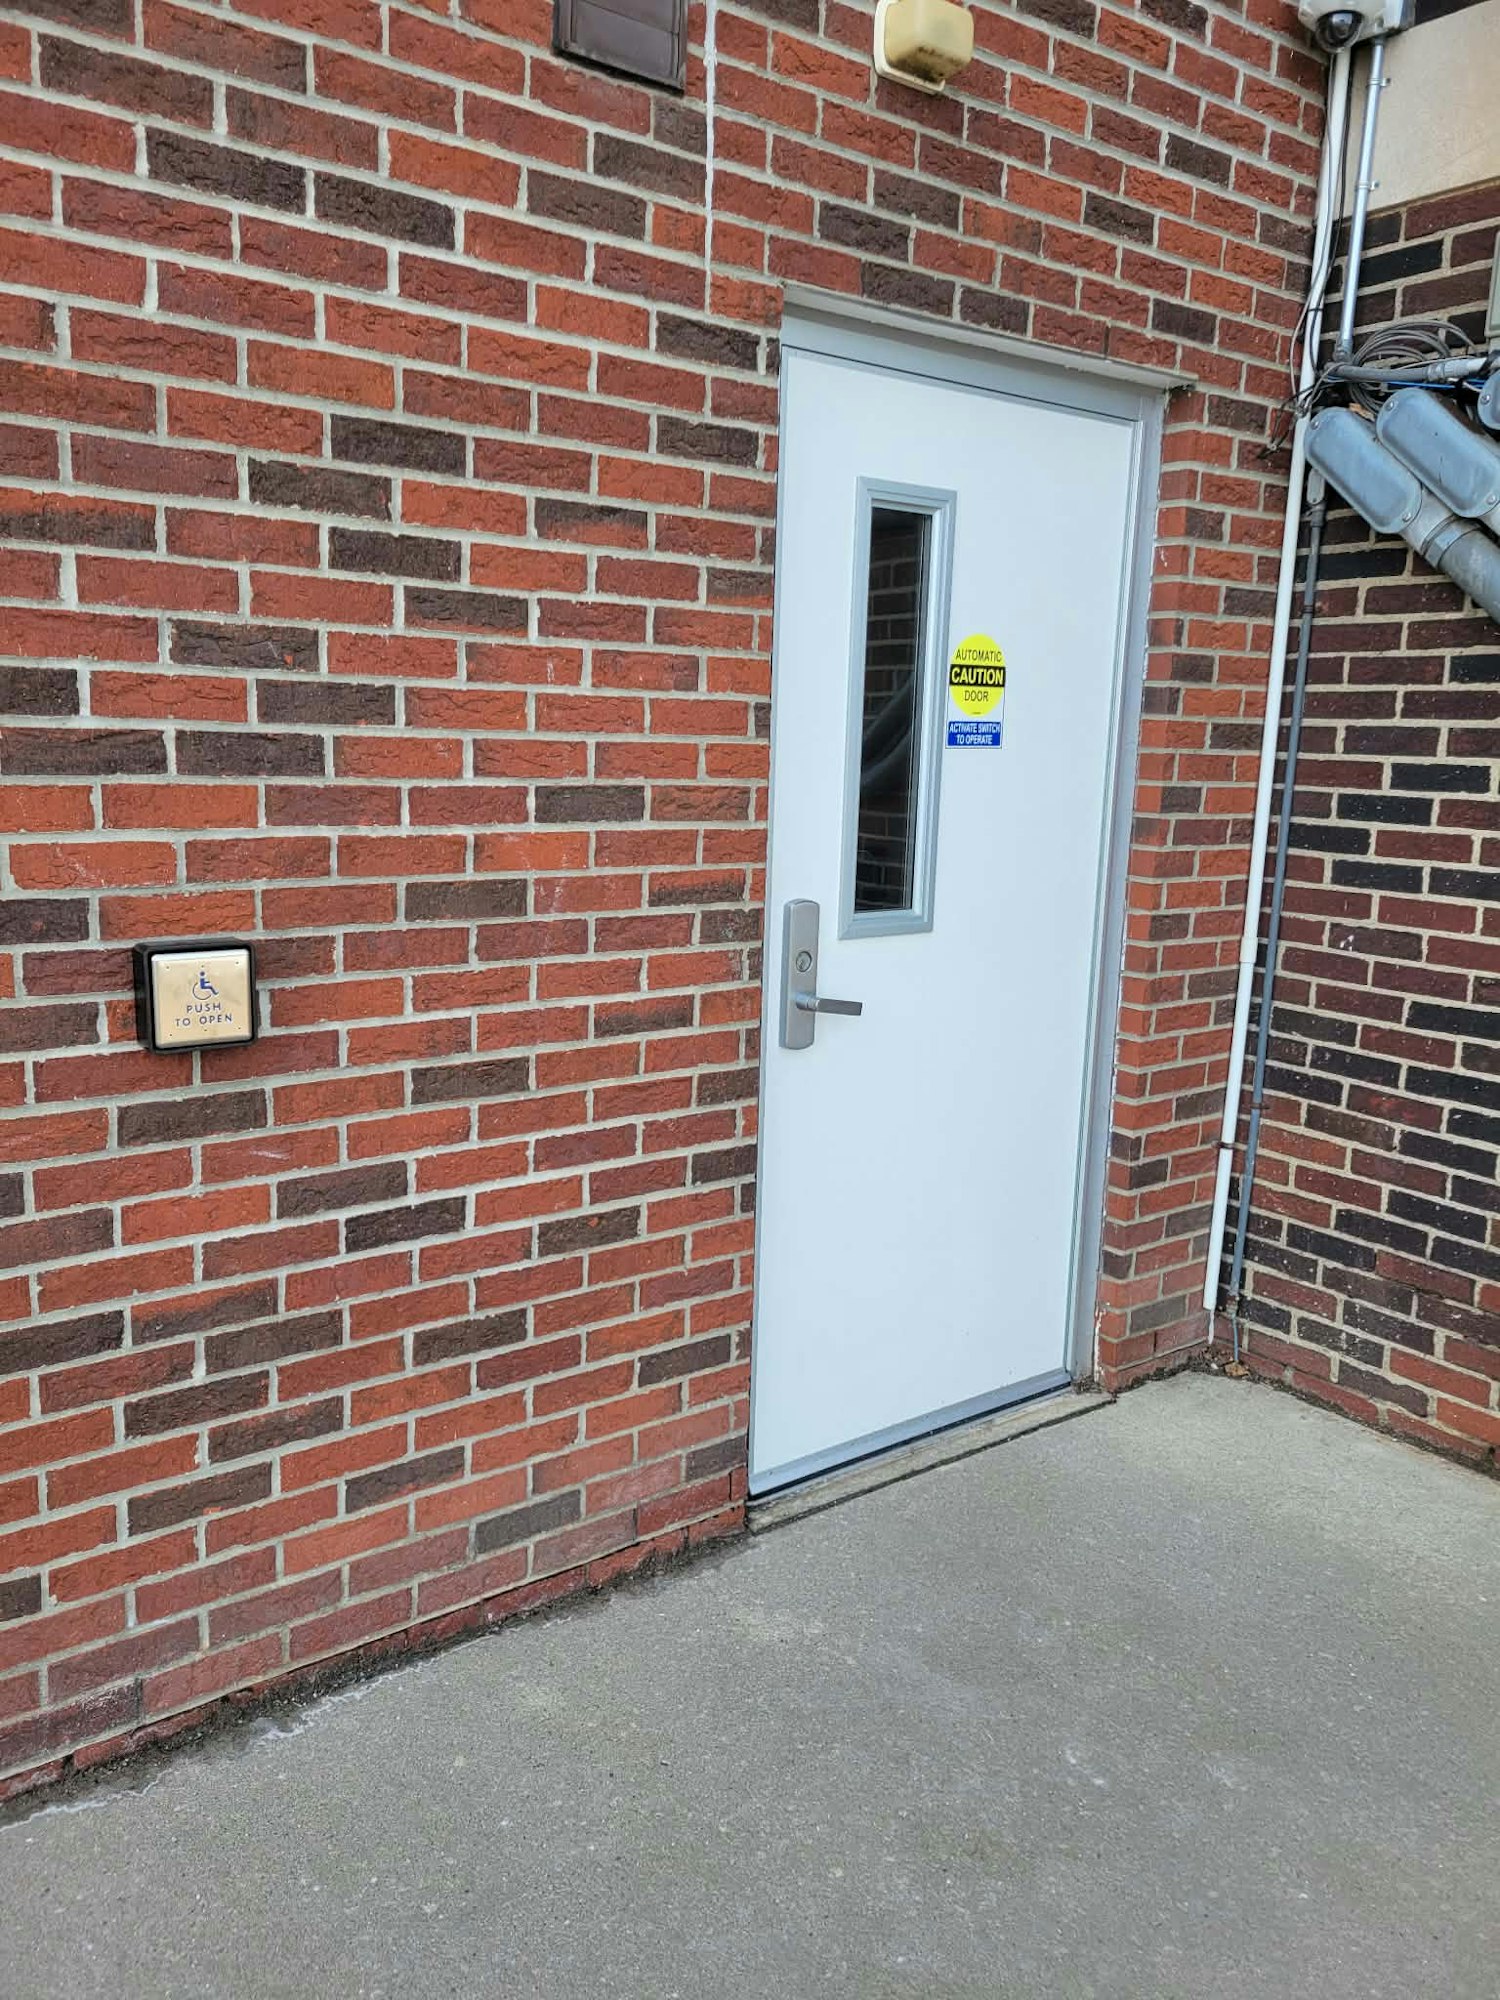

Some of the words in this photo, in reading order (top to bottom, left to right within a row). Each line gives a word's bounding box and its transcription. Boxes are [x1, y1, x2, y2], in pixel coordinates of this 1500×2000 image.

[955, 649, 1002, 662] AUTOMATIC
[951, 667, 1004, 685] CAUTION
[964, 690, 989, 702] DOOR
[949, 723, 977, 734] ACTIVATE
[978, 724, 1000, 734] SWITCH
[956, 734, 965, 744] TO
[966, 734, 993, 745] OPERATE
[186, 1003, 221, 1013] PUSH
[175, 1018, 191, 1027] TO
[199, 1014, 232, 1024] OPEN
